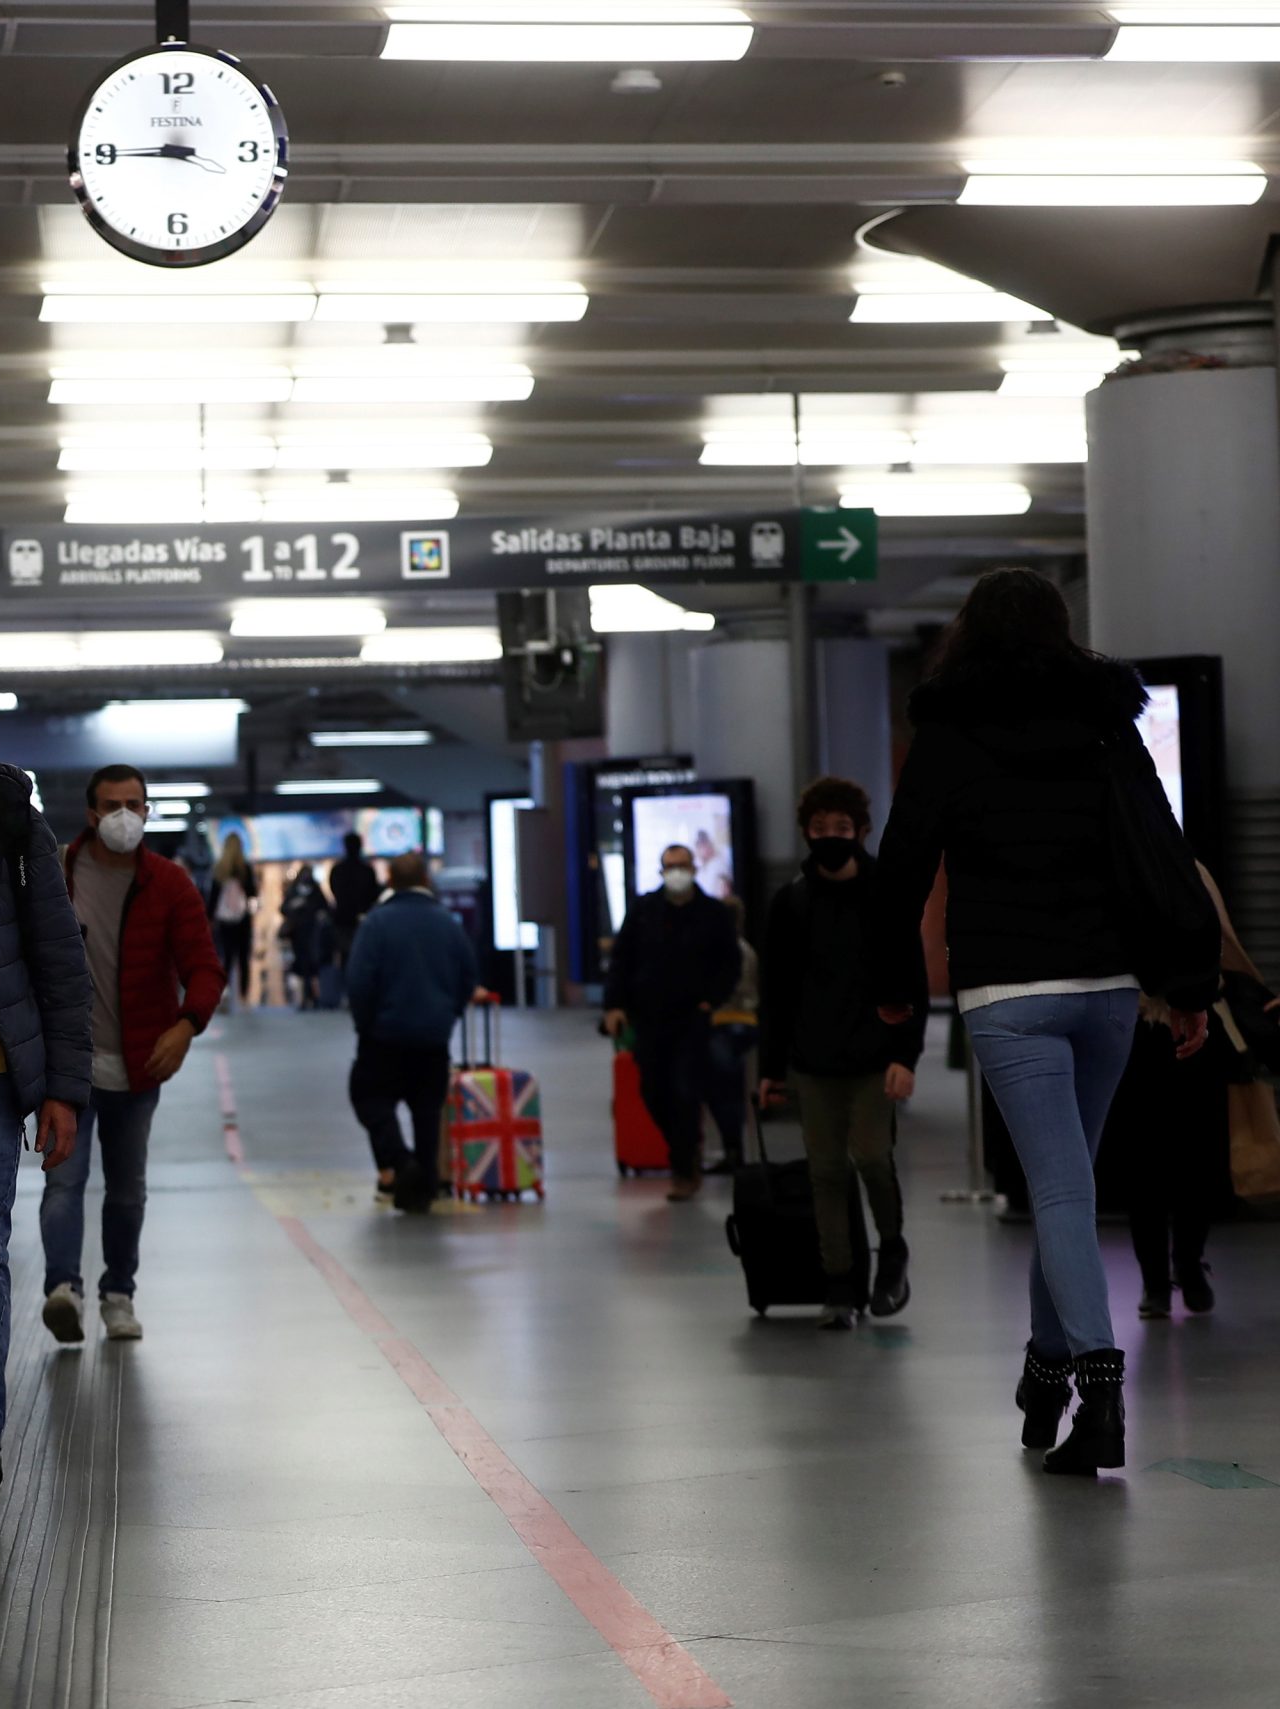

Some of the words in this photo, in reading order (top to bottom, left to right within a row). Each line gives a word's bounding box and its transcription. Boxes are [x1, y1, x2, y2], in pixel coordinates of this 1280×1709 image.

[158, 72, 195, 95] 12
[151, 117, 203, 128] FESTINA
[95, 143, 117, 166] 9
[237, 140, 258, 163] 3
[167, 212, 188, 235] 6
[490, 527, 583, 555] Salidas
[589, 527, 671, 551] Planta
[679, 524, 736, 552] Baja
[57, 540, 169, 569] Llegadas
[172, 536, 227, 563] Vías
[240, 535, 273, 581] 1
[293, 532, 361, 580] 12
[545, 557, 630, 574] DEPARTURES
[631, 556, 688, 571] GROUND
[691, 555, 736, 570] FLOOR
[59, 569, 122, 585] ARRIVALS
[124, 567, 202, 584] PLATFORMS
